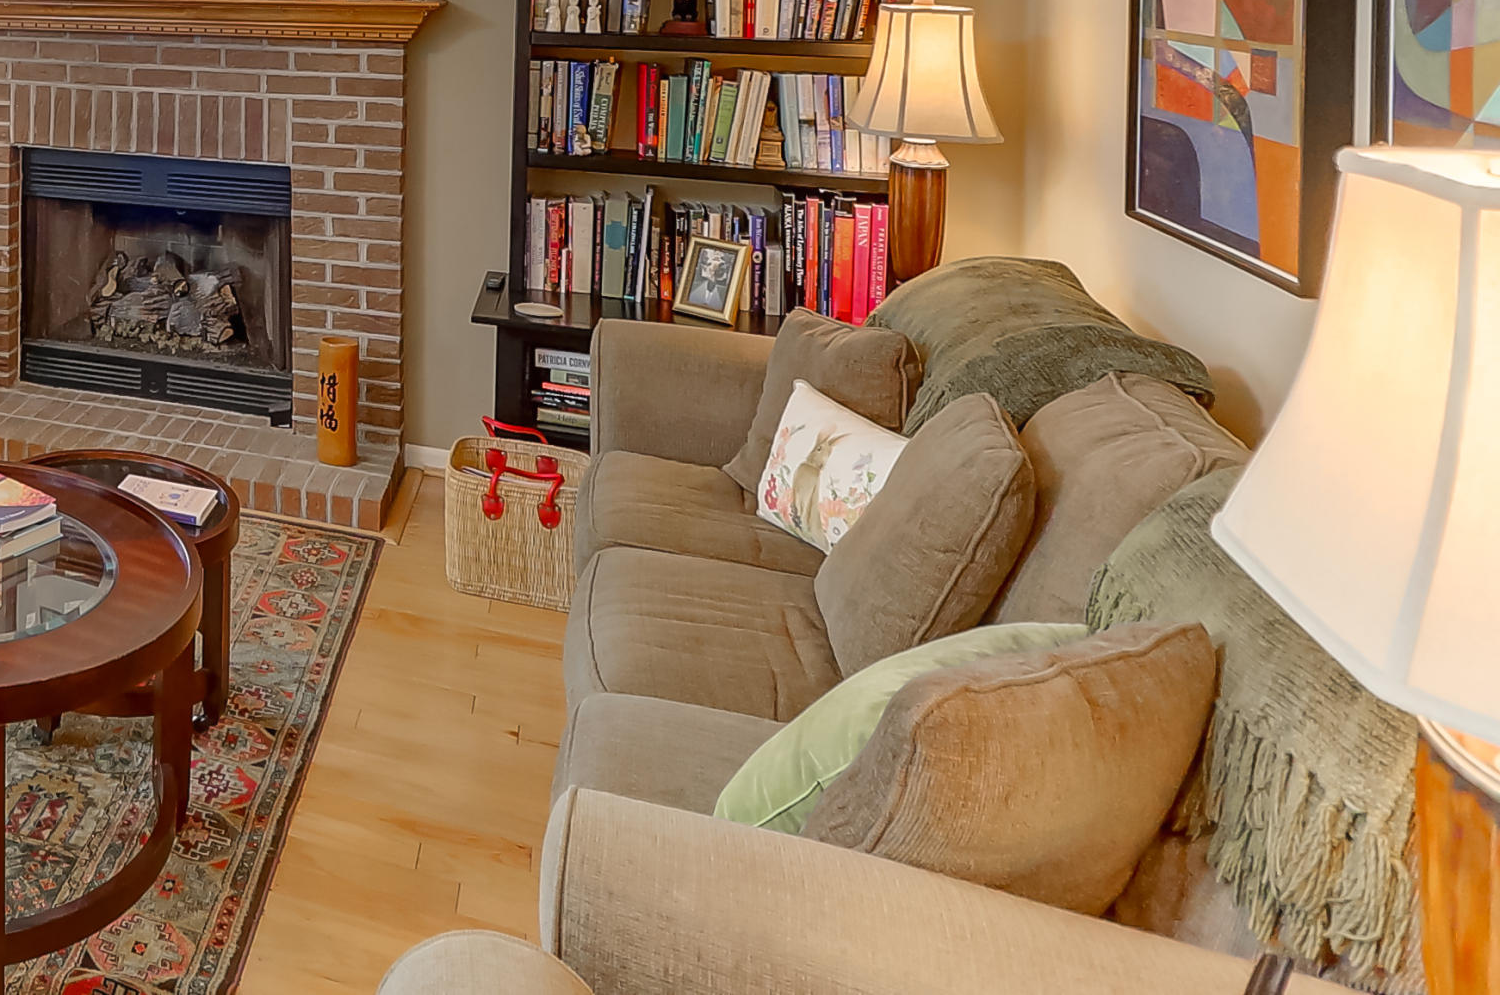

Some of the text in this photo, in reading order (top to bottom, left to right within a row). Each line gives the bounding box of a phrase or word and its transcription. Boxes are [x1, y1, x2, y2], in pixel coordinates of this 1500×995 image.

[589, 105, 601, 130] POEMS
[596, 98, 610, 139] COMPLETE
[784, 204, 793, 229] ALASKA
[796, 209, 804, 220] The
[796, 221, 805, 233] Atlas
[856, 213, 869, 247] JAPAN
[795, 240, 805, 267] Legendary
[795, 268, 803, 286] Places
[876, 256, 885, 281] LLOYD
[538, 354, 567, 366] PATRICIA
